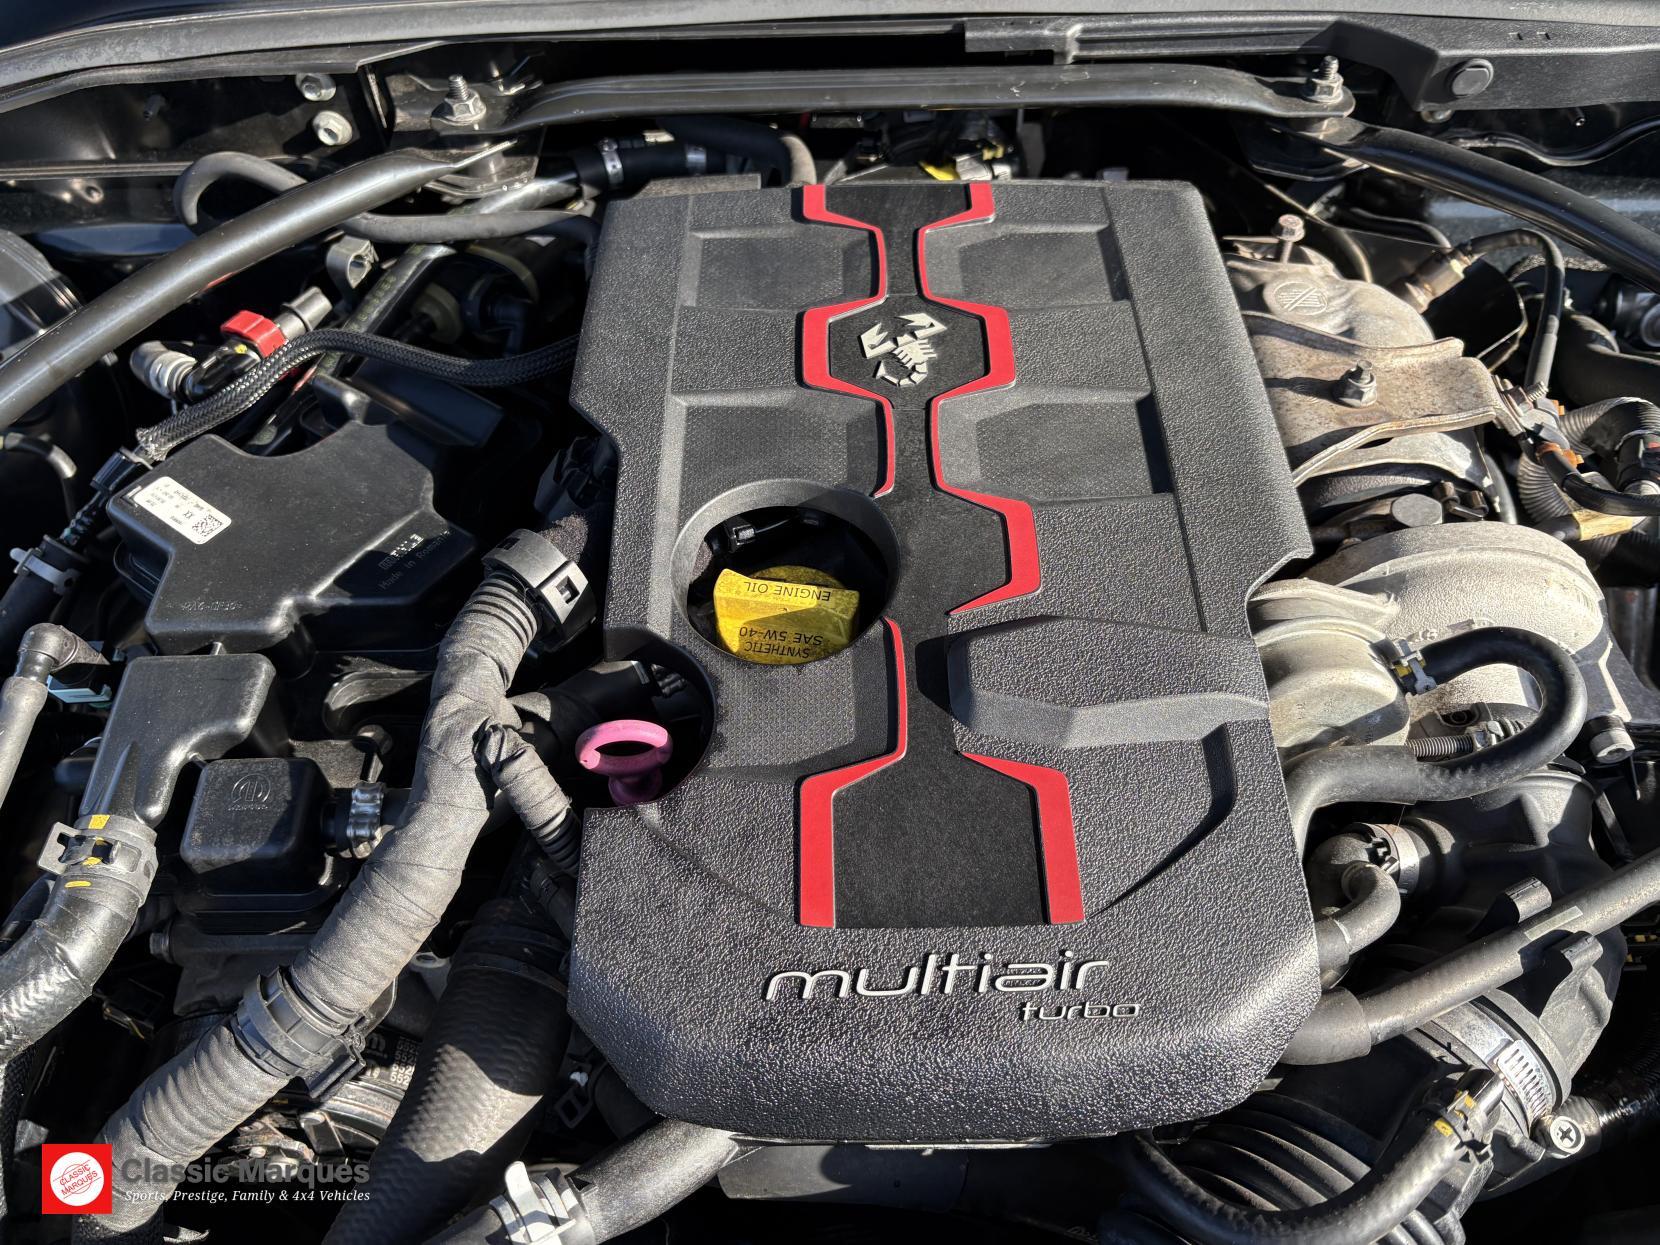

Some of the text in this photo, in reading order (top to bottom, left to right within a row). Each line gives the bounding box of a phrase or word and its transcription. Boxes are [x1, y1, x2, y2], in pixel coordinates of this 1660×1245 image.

[744, 581, 832, 602] ENGINE OIL
[739, 626, 824, 646] SAE 5W-40
[744, 641, 810, 659] SYNTHETIC
[766, 950, 1110, 1000] multiair
[1022, 1001, 1141, 1021] turbo
